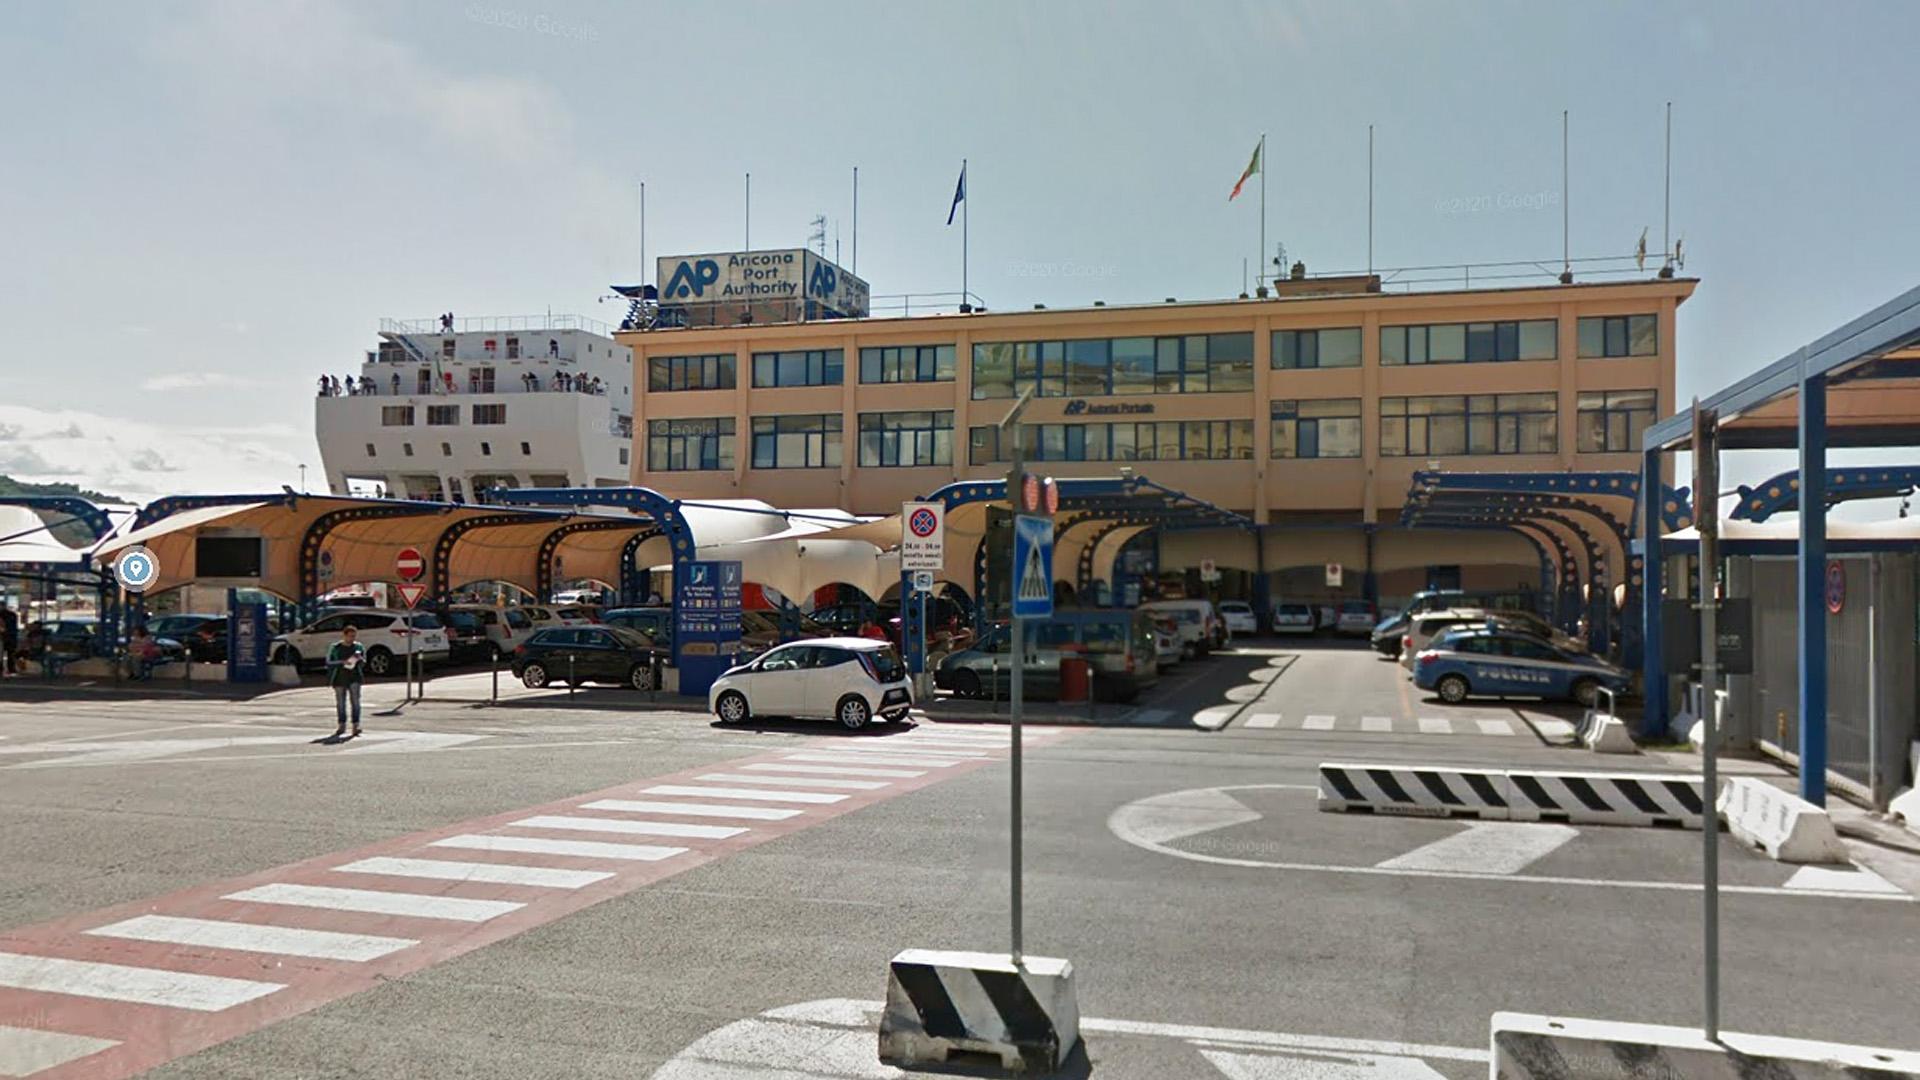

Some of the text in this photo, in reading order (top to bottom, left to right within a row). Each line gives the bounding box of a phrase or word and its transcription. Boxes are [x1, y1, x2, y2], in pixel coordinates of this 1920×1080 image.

[728, 253, 794, 267] Ancona
[743, 266, 778, 280] Port
[1477, 663, 1551, 683] POLIZIA
